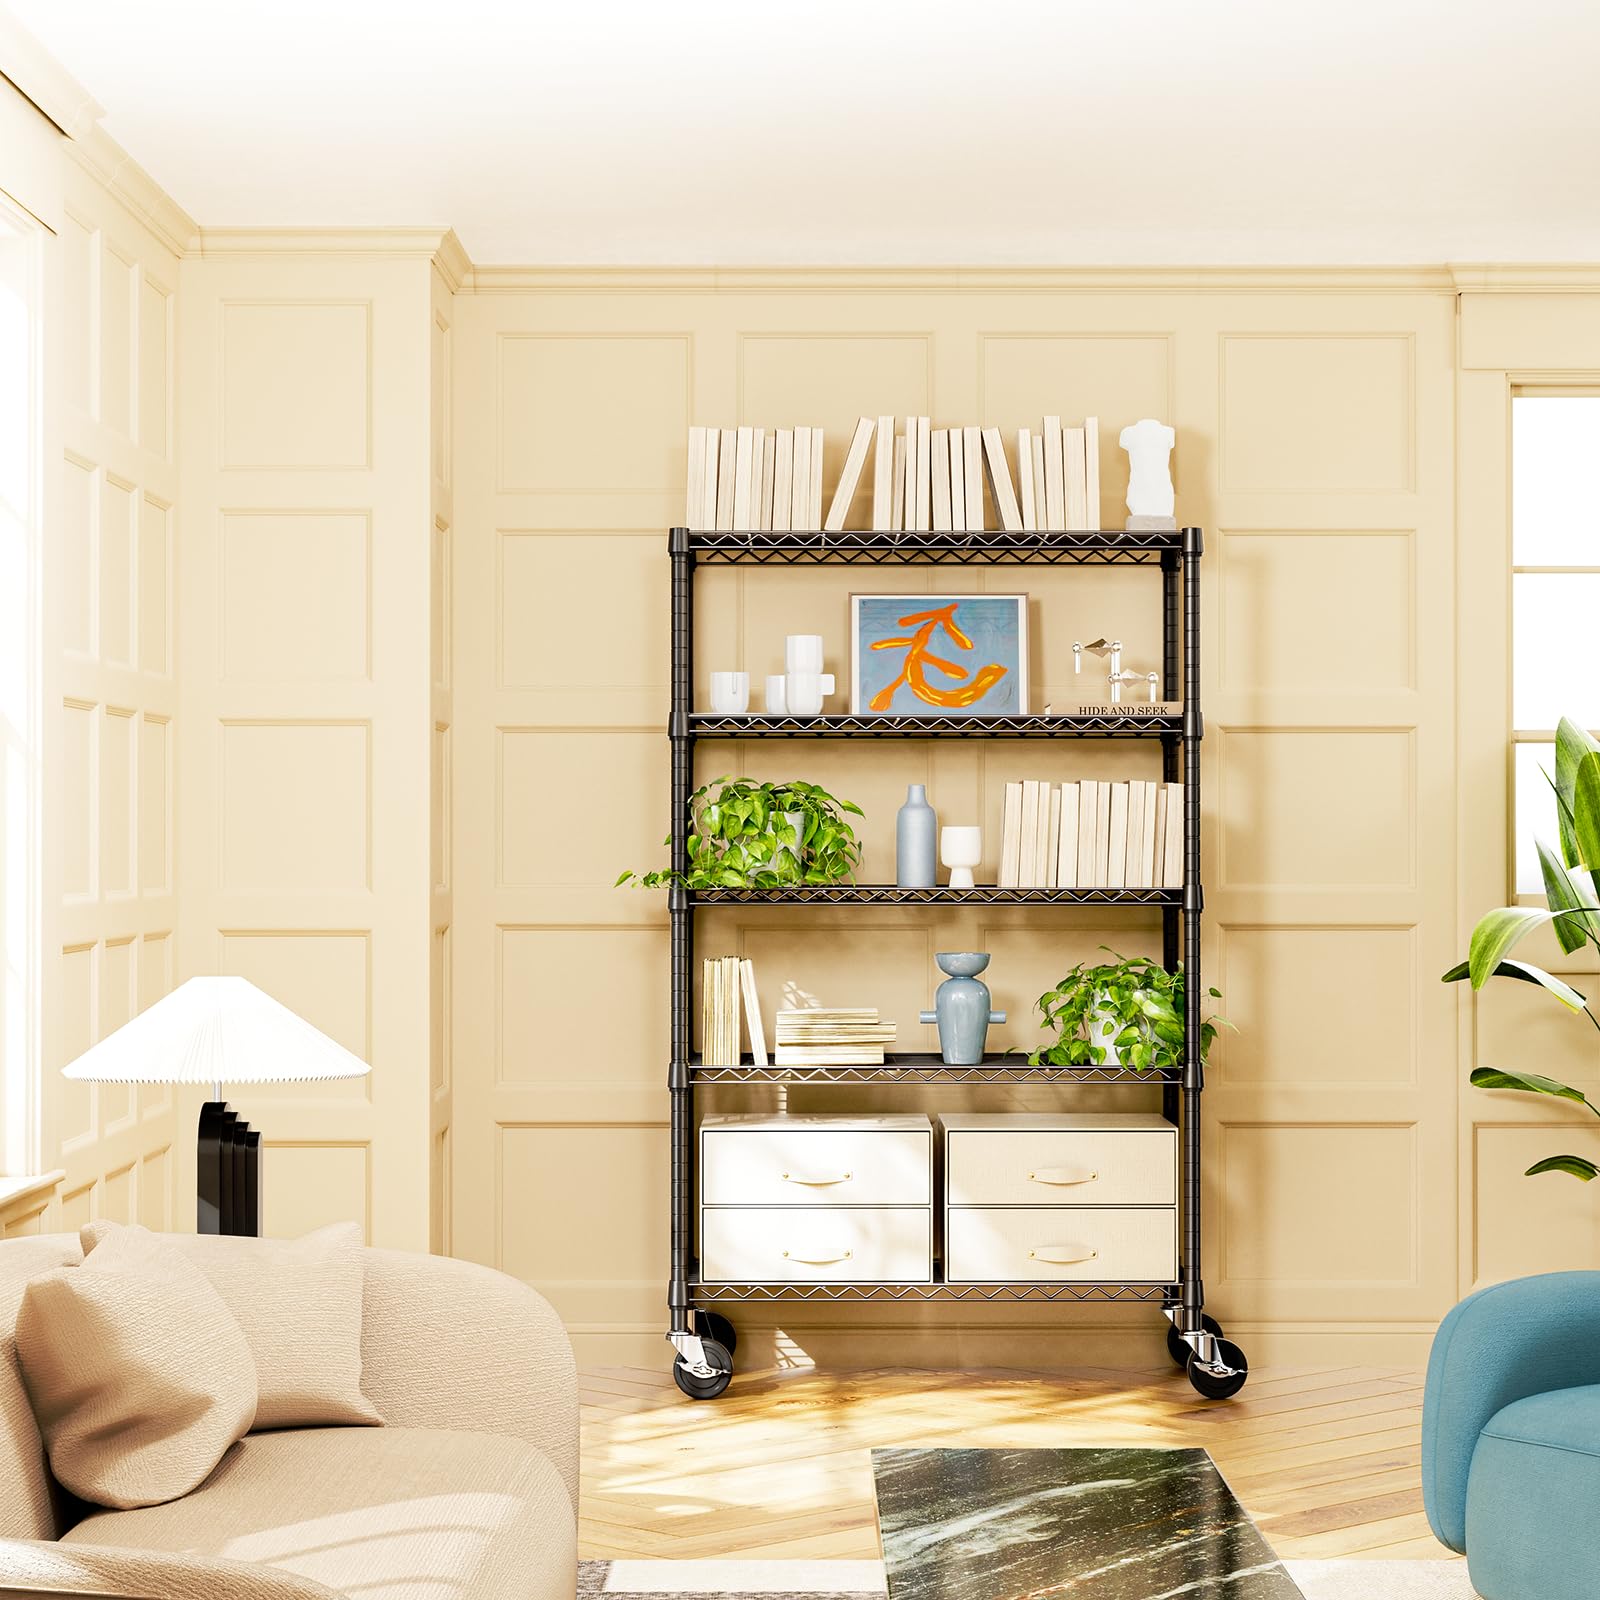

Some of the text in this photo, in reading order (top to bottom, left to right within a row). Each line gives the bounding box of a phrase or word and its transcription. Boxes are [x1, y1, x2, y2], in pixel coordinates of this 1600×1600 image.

[1079, 706, 1168, 716] HIDE AND SEEK
